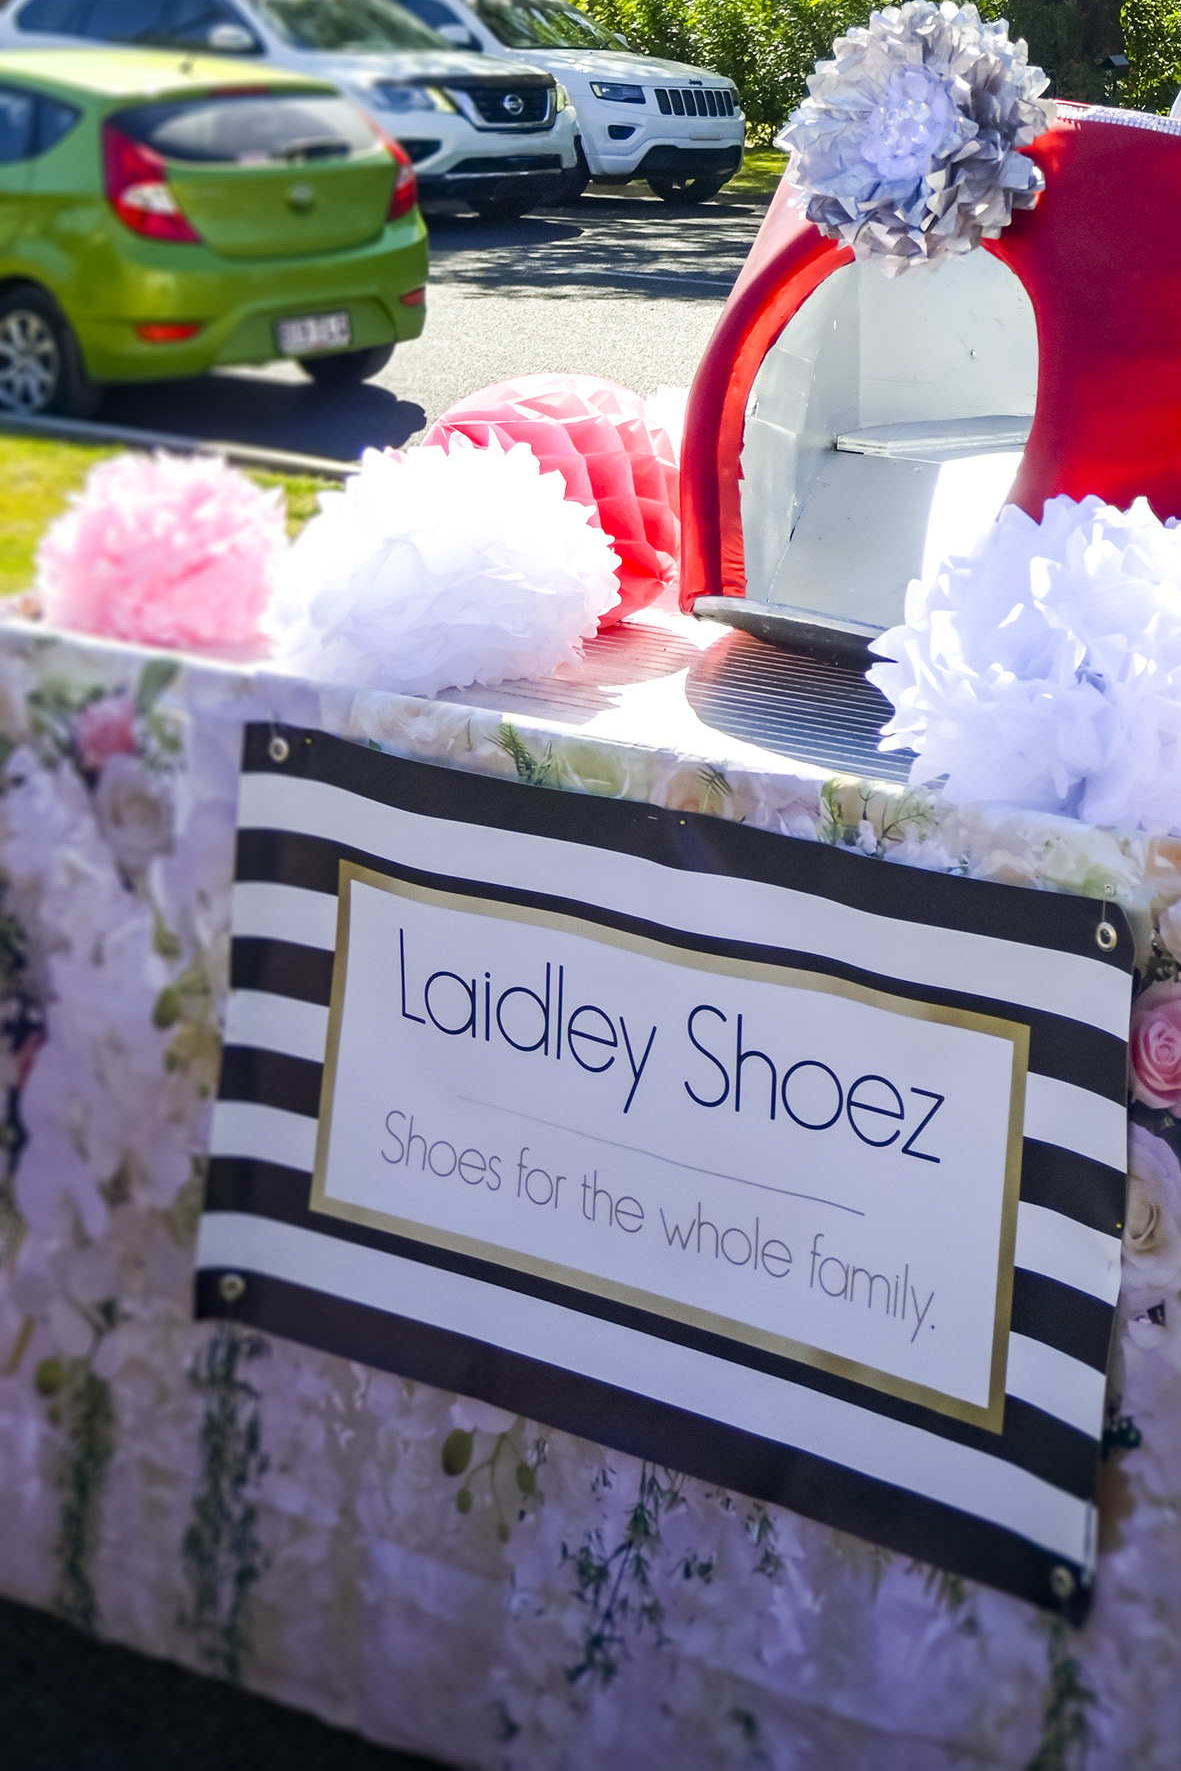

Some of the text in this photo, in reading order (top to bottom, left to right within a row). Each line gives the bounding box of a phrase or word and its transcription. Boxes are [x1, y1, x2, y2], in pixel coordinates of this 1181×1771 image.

[399, 928, 945, 1164] Laidley Shoez
[381, 1110, 937, 1343] Shoes for the whole family.
